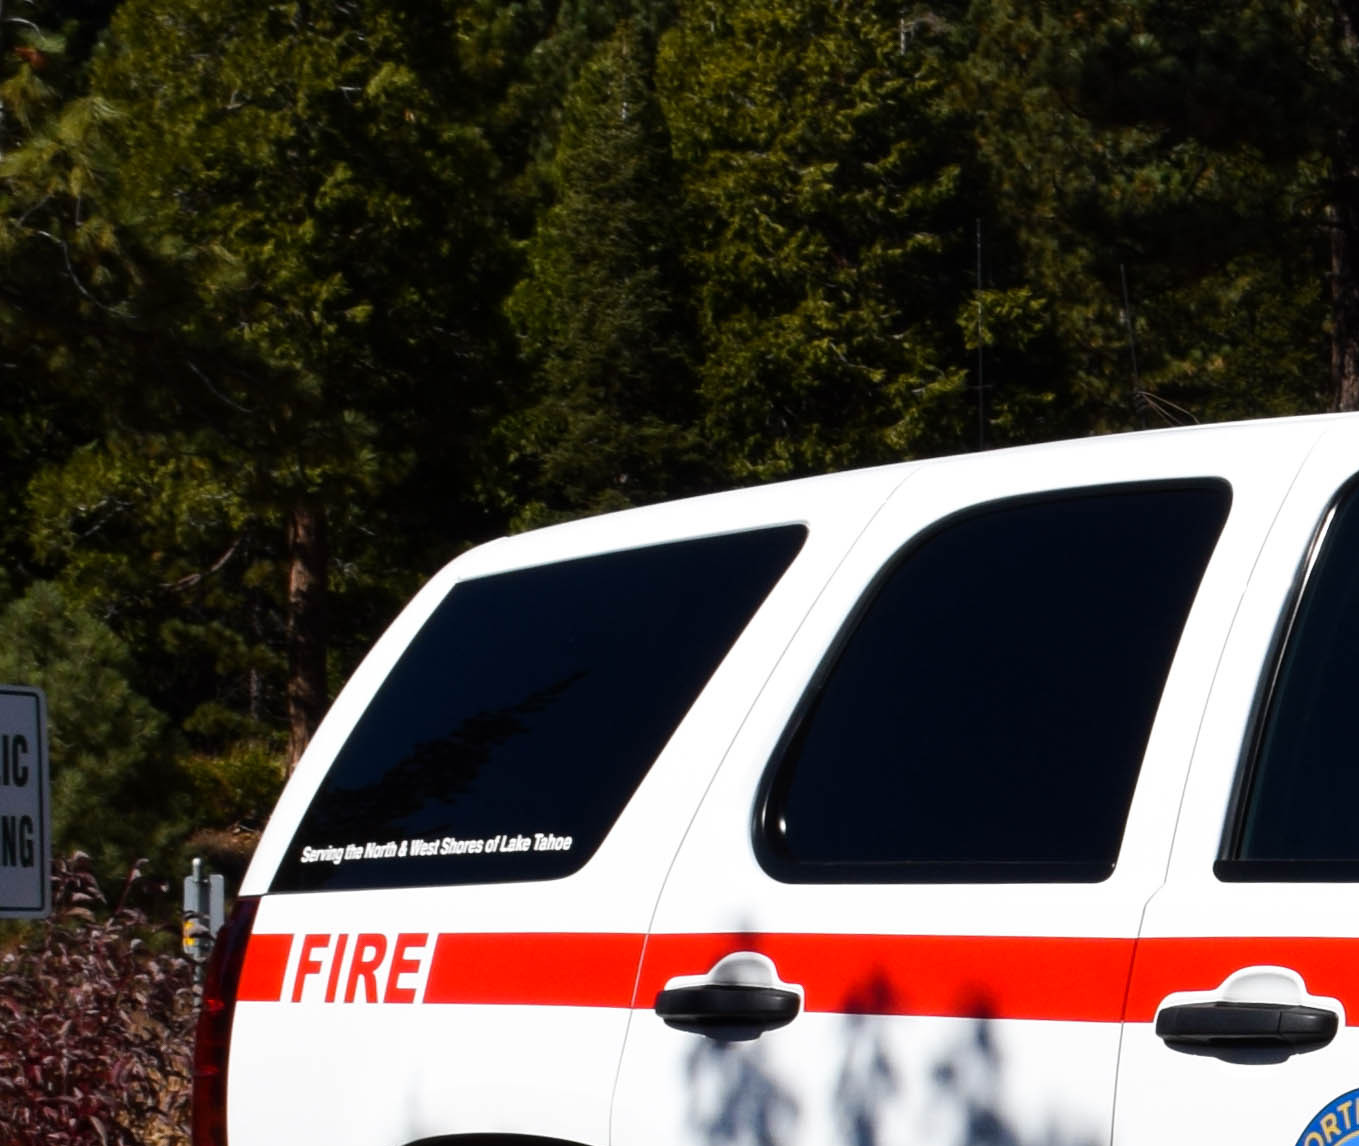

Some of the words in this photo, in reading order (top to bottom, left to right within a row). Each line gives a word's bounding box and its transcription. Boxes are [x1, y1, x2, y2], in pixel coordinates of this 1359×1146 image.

[0, 733, 29, 787] IC
[301, 845, 344, 865] Serving
[344, 843, 364, 860] the
[364, 841, 398, 858] North
[398, 840, 408, 857] &
[410, 839, 439, 856] West
[440, 837, 484, 855] Shores
[485, 835, 501, 853] of
[500, 834, 531, 852] Lake
[534, 833, 573, 851] Tahoe
[291, 932, 430, 1004] FIRE
